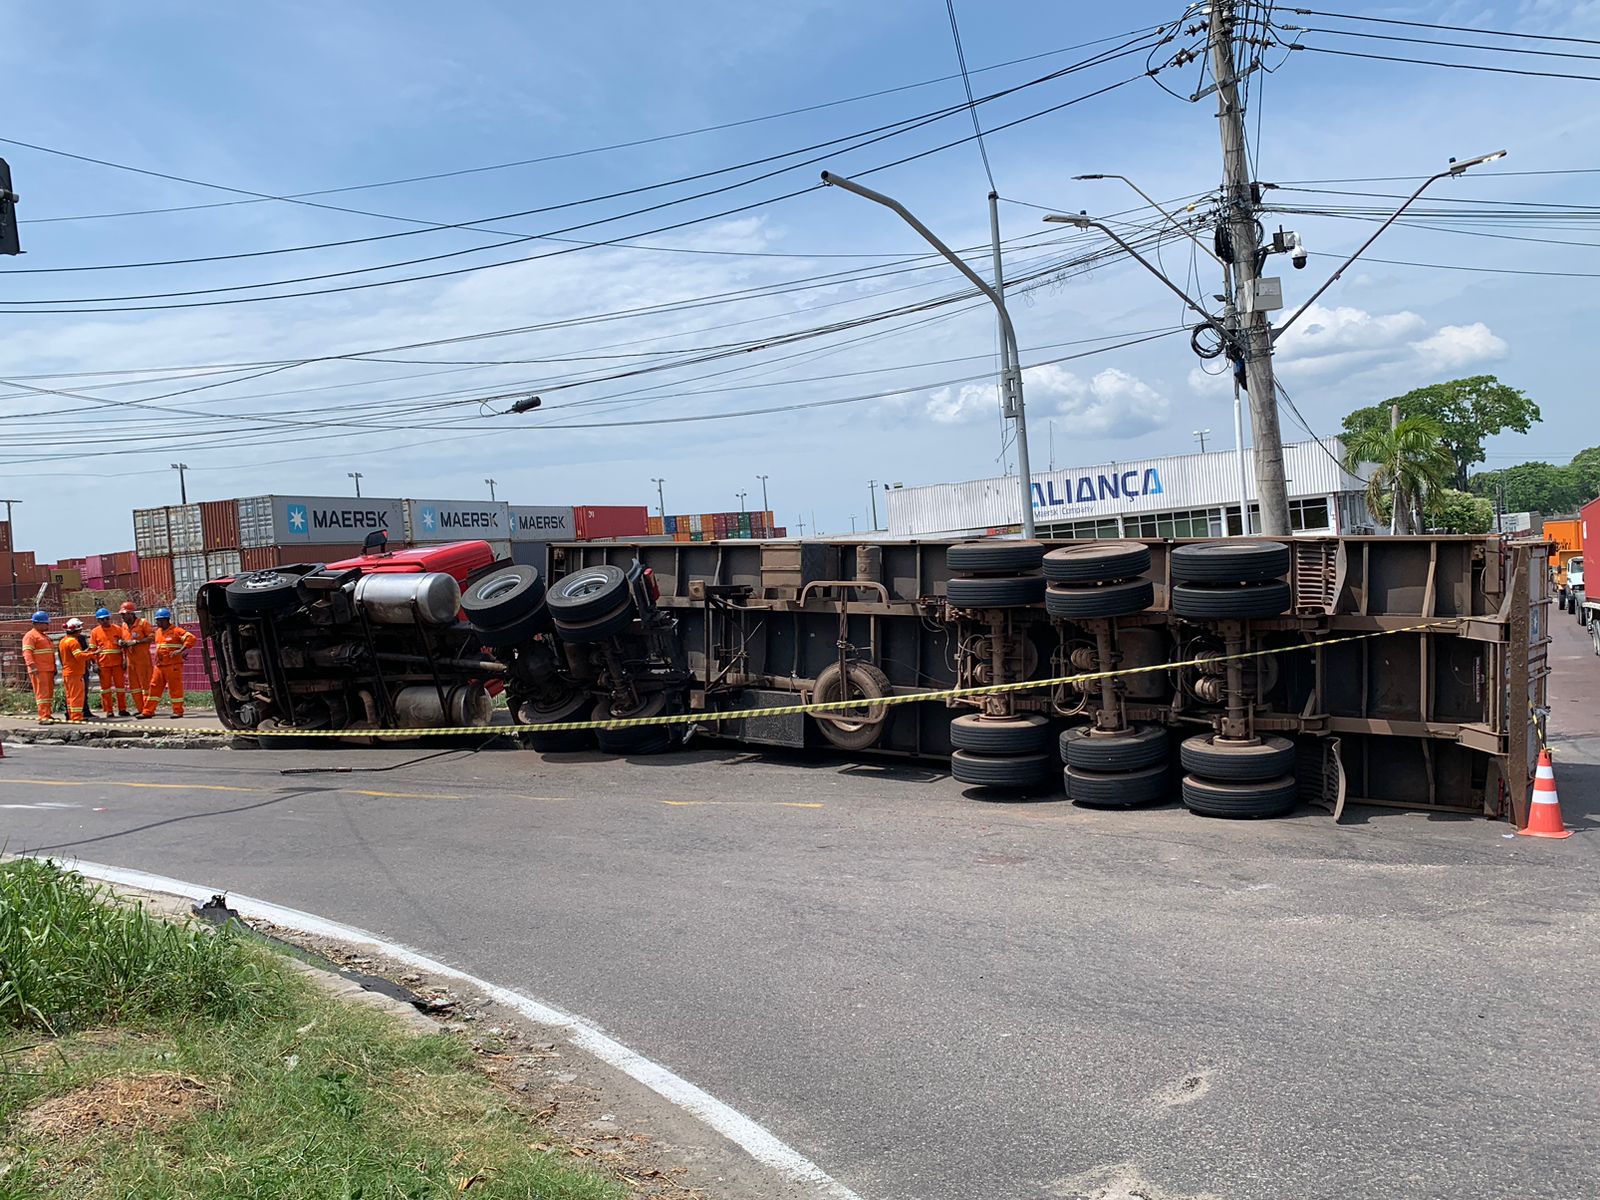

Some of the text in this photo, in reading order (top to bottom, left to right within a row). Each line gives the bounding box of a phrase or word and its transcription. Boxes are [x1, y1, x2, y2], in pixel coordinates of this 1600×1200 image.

[1031, 468, 1164, 508] ALIANÇA
[1061, 505, 1096, 516] Company
[313, 510, 389, 528] MAERSK
[440, 512, 498, 528] MAERSK
[519, 516, 565, 530] MAERSK
